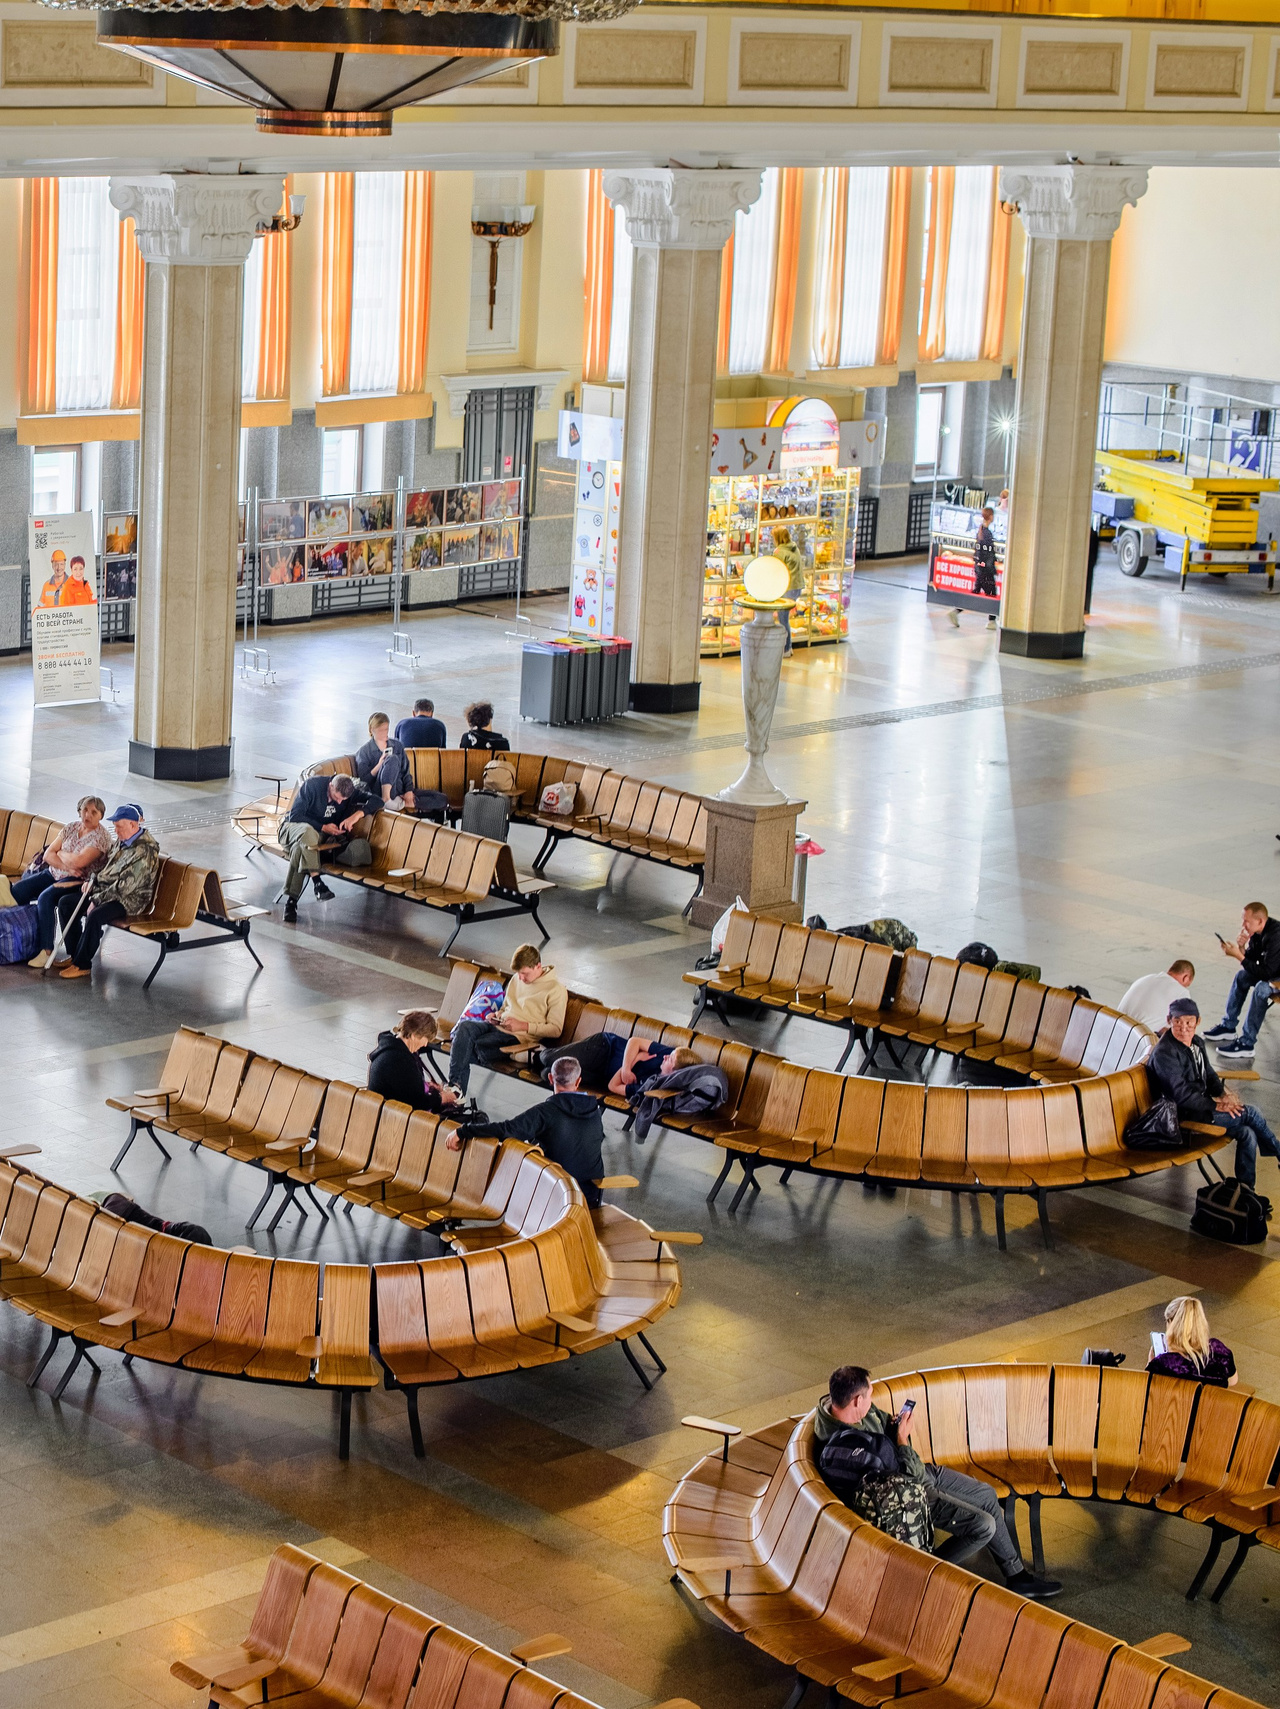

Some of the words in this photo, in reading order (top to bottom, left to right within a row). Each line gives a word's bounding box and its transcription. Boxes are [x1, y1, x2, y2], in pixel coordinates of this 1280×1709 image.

[940, 575, 972, 590] ХОРОШЕГО
[51, 611, 74, 620] РАБОТА
[46, 619, 61, 627] ВСЕЙ
[62, 618, 84, 626] СТРАНЕ
[55, 651, 85, 659] БЕСПЛАТНО
[44, 660, 57, 669] 800
[73, 658, 82, 666] 44
[83, 657, 92, 666] 10
